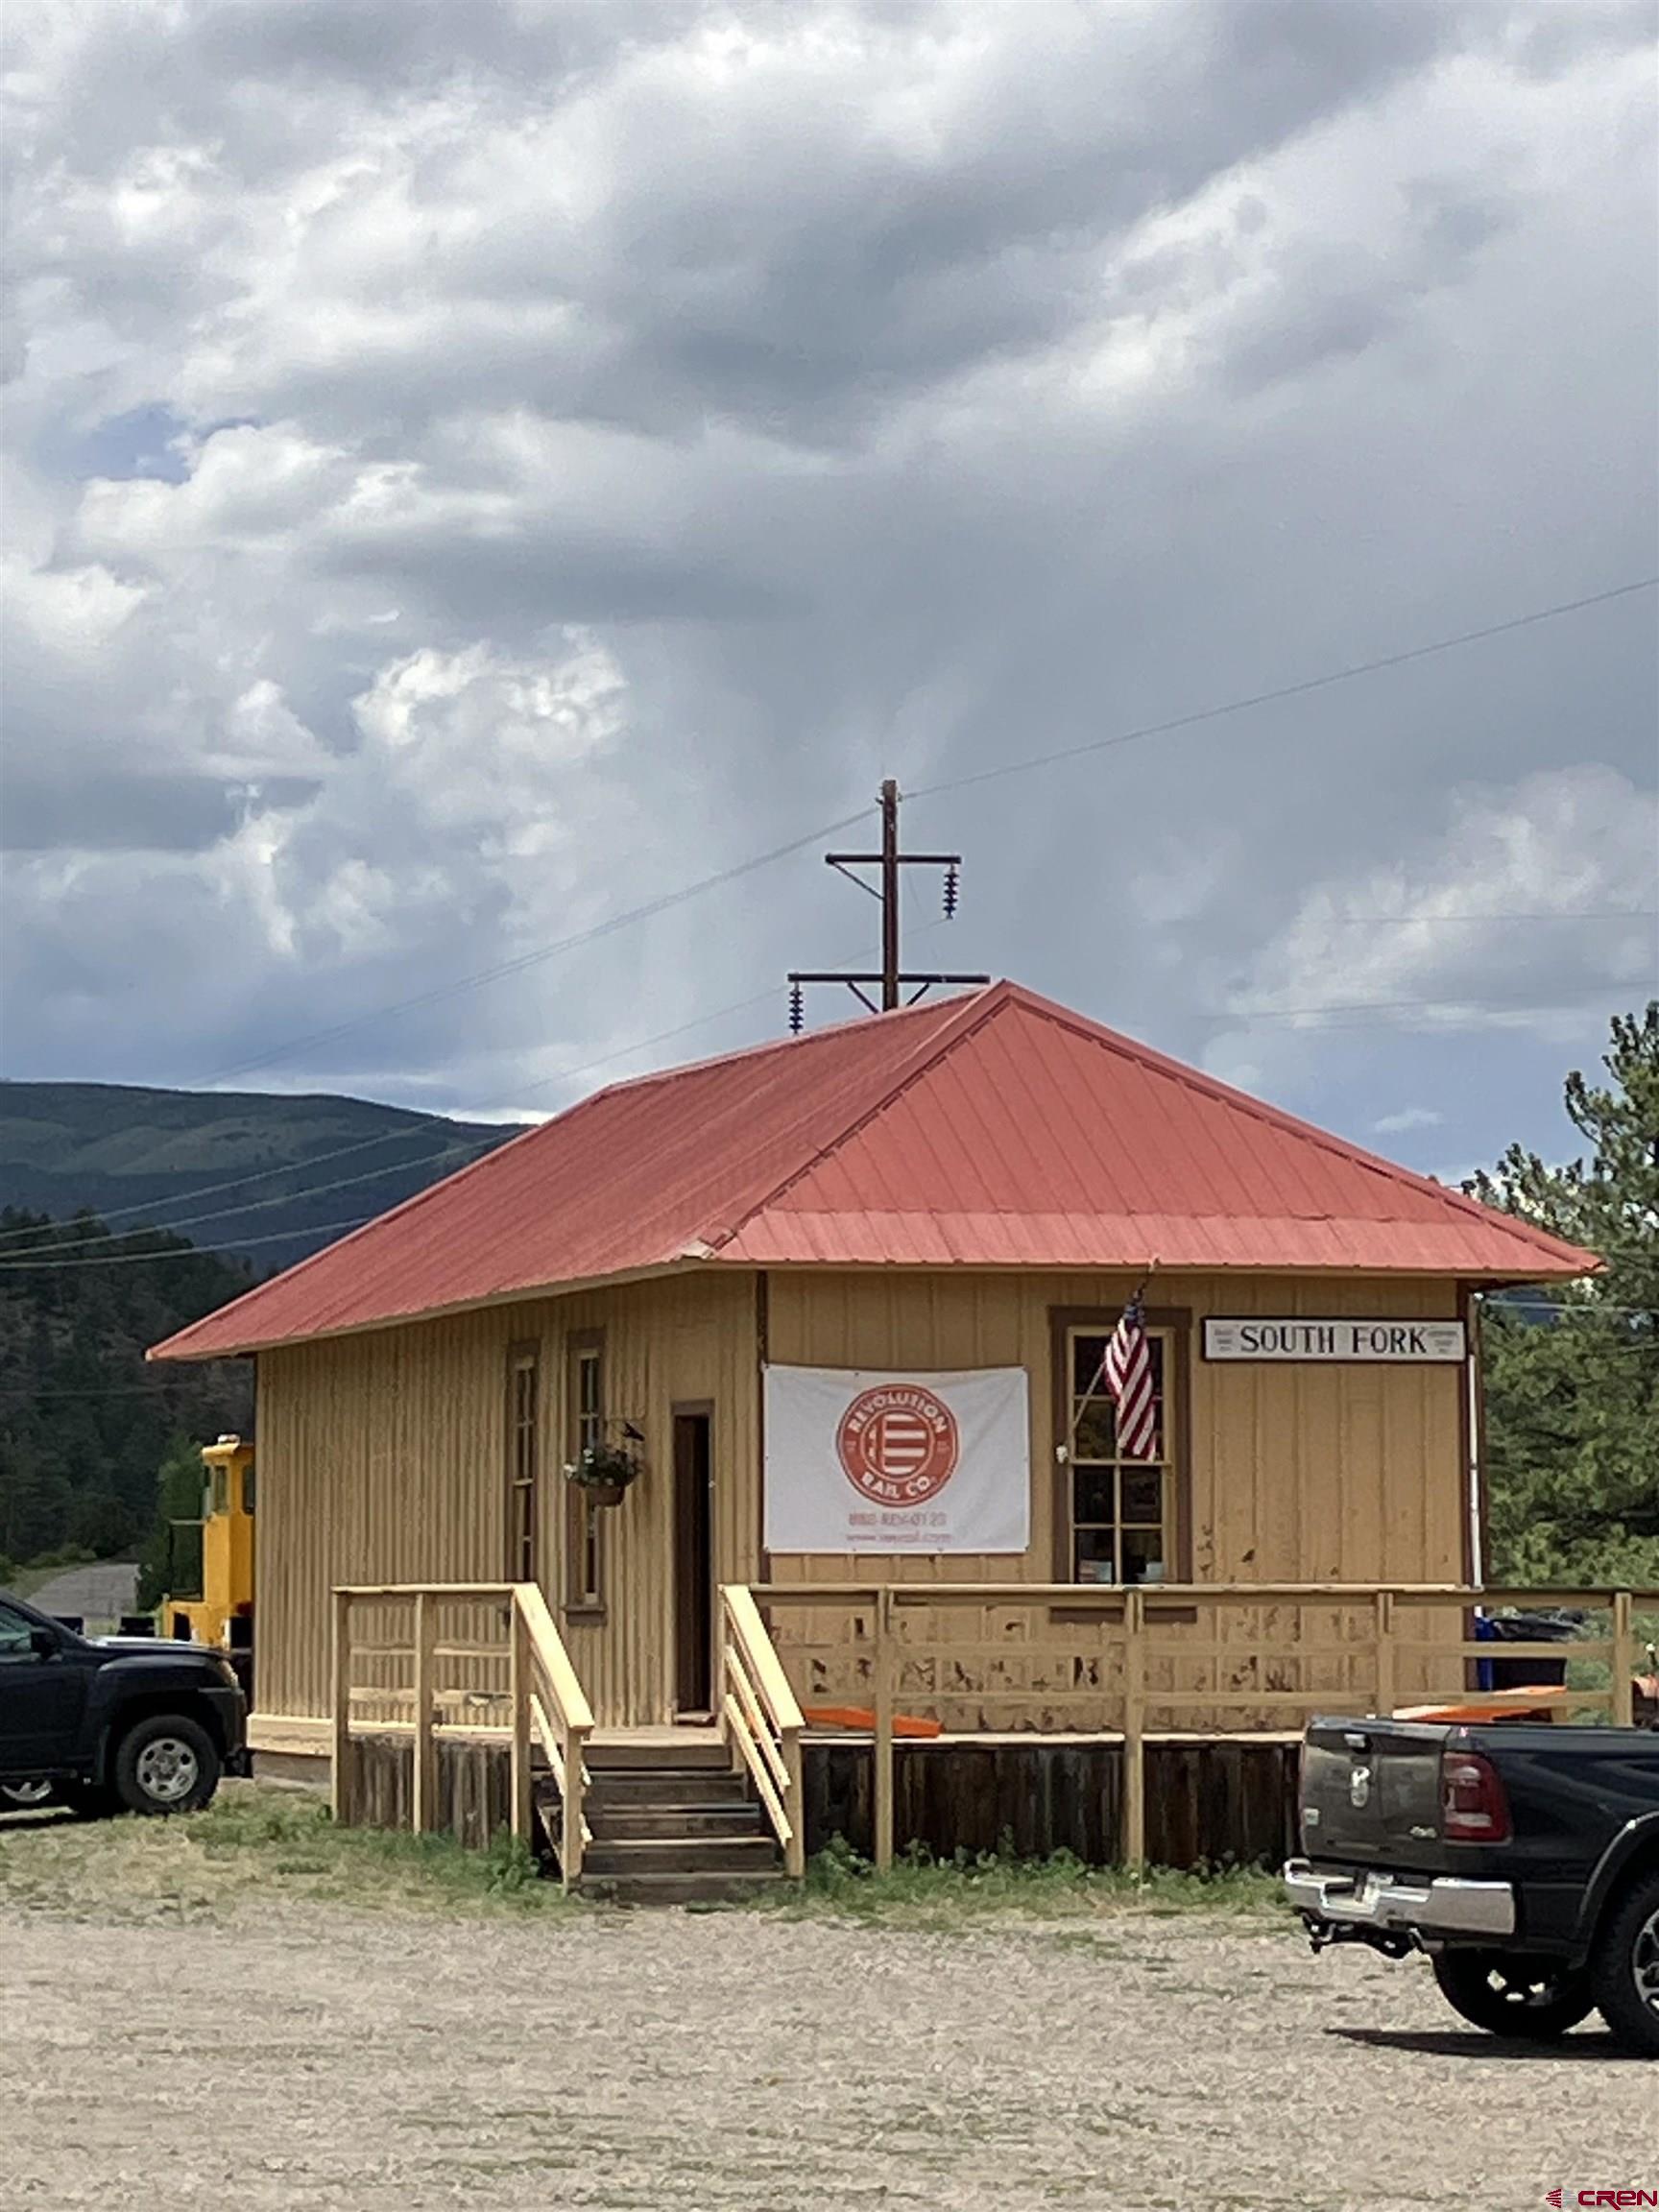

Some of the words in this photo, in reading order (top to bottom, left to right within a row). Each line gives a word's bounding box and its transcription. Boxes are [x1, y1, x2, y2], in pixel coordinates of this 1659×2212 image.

[1240, 1325, 1335, 1355] SOUTH
[1351, 1325, 1428, 1355] FORK
[848, 1392, 948, 1433] REVOLUTION
[861, 1471, 901, 1499] RAIL
